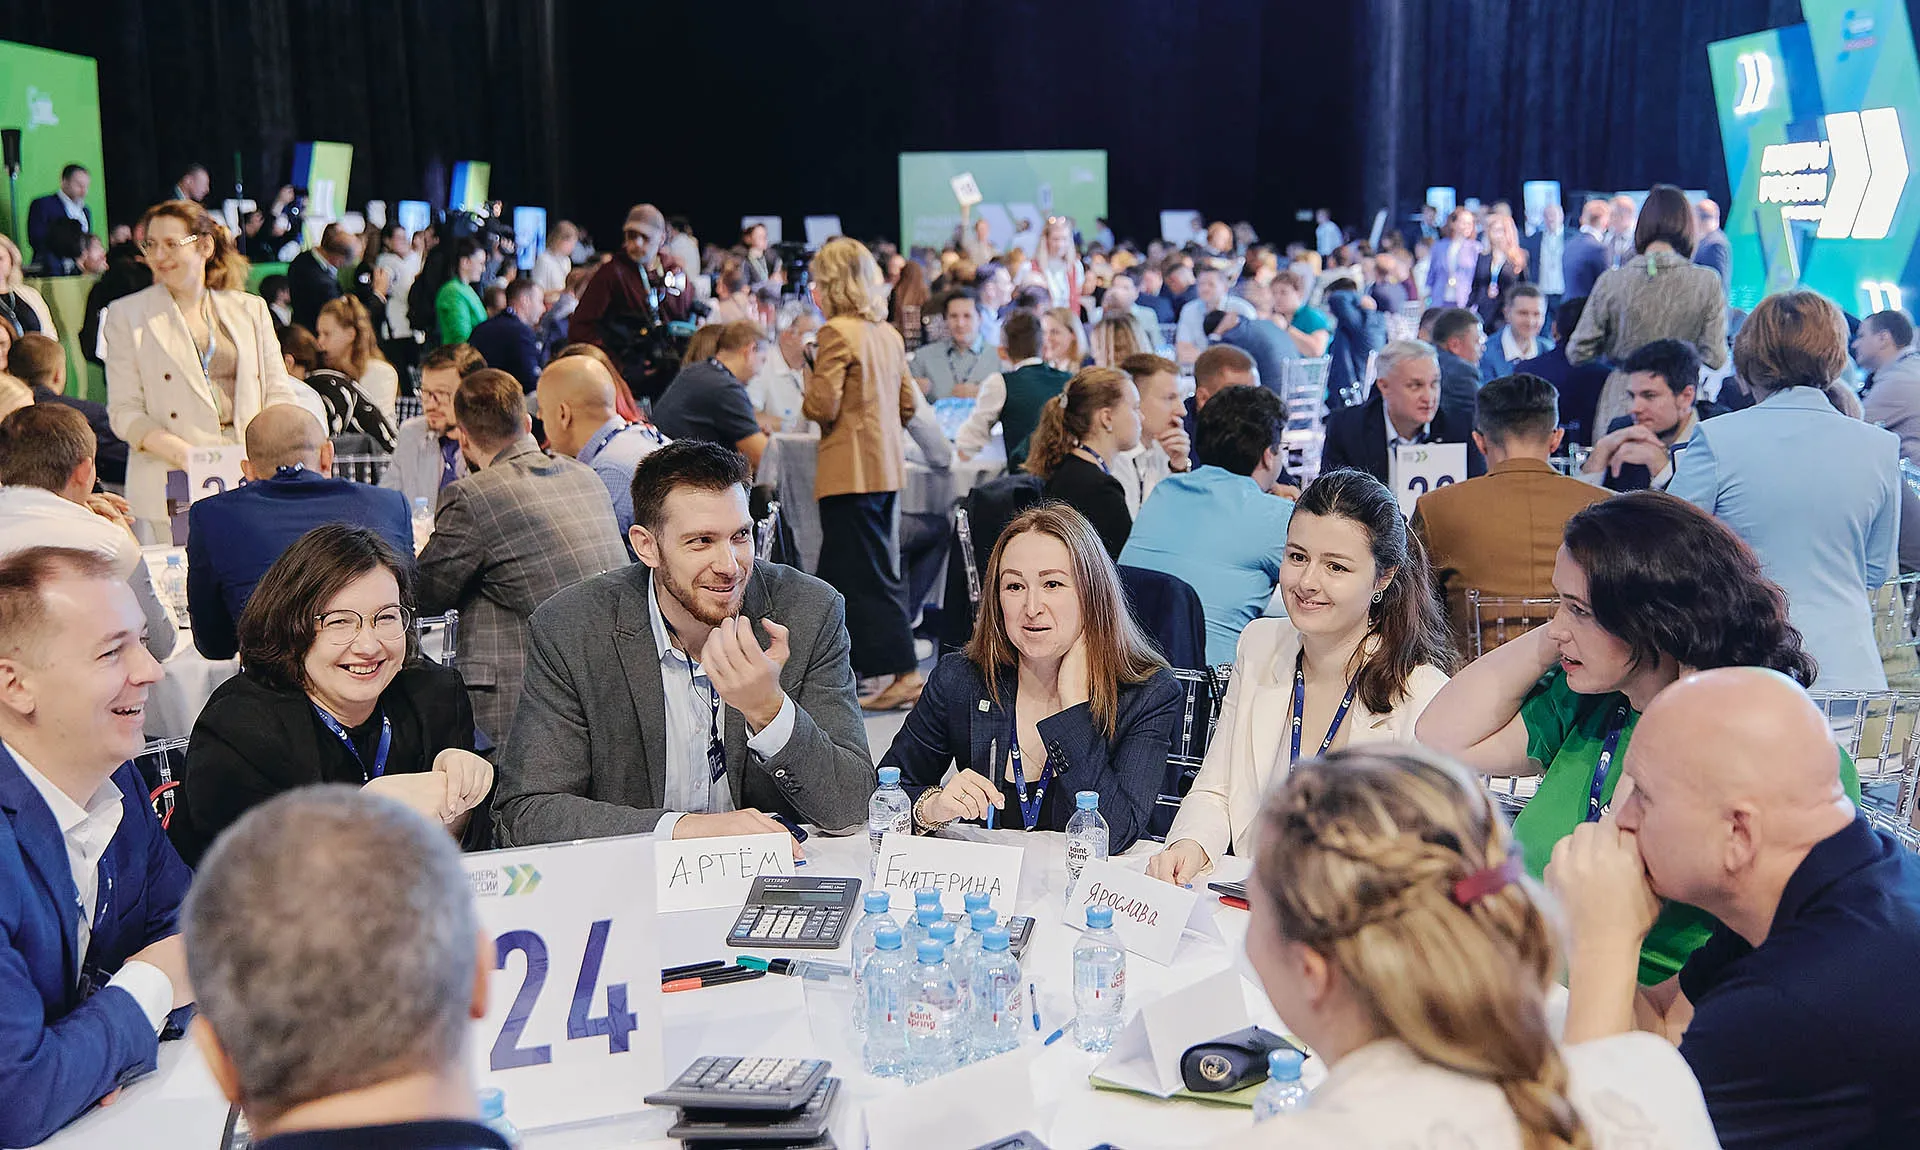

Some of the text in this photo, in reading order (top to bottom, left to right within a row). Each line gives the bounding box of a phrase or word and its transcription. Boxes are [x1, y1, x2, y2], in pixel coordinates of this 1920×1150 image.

[669, 847, 783, 888] АРТЁМ
[468, 869, 498, 881] ИДЕРЫ
[490, 919, 638, 1072] 24
[910, 1012, 932, 1021] saint
[908, 1017, 936, 1030] spring
